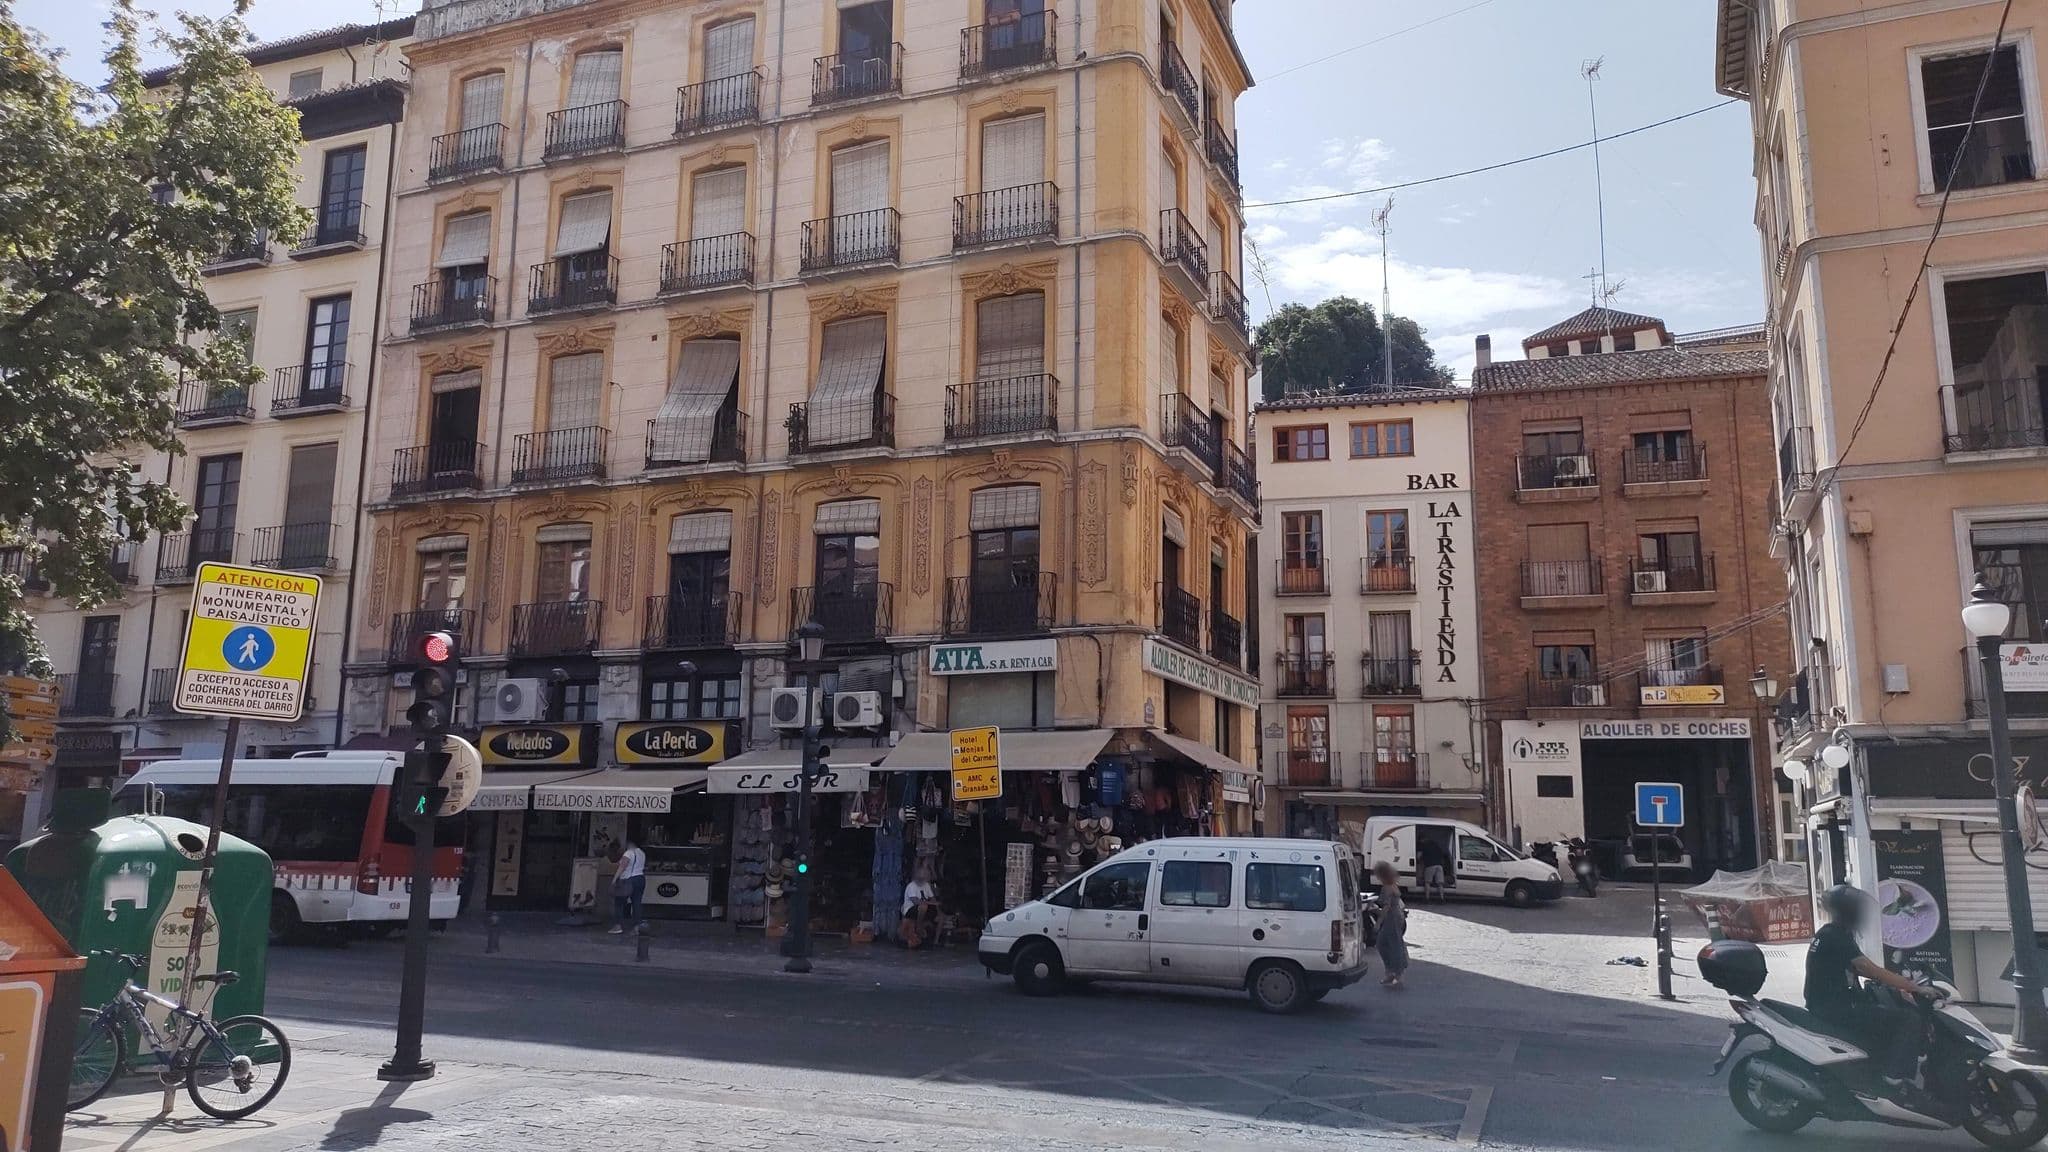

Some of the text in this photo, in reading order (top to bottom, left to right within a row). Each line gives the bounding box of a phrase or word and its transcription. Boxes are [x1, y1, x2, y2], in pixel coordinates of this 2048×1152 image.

[1406, 472, 1460, 490] BAR
[1427, 501, 1463, 518] LA
[216, 572, 305, 592] ATENCIÓN
[218, 586, 297, 605] ITINERARIO
[1436, 521, 1456, 683] TRASTIENDA
[202, 596, 310, 617] MONUMENTAL Y
[207, 608, 301, 627] PAISAJÍSTICO
[1010, 657, 1029, 669] RENT
[1031, 657, 1037, 668] A
[1038, 656, 1053, 667] CAR
[196, 673, 289, 691] EXCEPTO ACCESO A
[1151, 645, 1178, 677] ALQUILER
[1178, 656, 1186, 679] DE
[1187, 659, 1208, 689] COCHES
[1208, 667, 1219, 692] CON
[1224, 674, 1232, 696] SIN
[1232, 678, 1258, 706] CONDUCTOR
[188, 683, 294, 701] COCHERAS Y HOTELES
[185, 694, 293, 712] POR CARRERA DEL DARRO
[1583, 722, 1748, 738] ALQUILER DE COCHES
[644, 730, 697, 750] La Perla
[959, 736, 978, 744] Hotel
[1535, 742, 1570, 755] ATA
[960, 746, 984, 755] Monjas
[960, 754, 997, 764] del Carmen
[736, 773, 773, 789] EL
[967, 774, 983, 782] AMC
[962, 785, 989, 793] Granada
[480, 794, 525, 808] CHUFAS
[537, 795, 668, 810] HELADOS ARTESANOS
